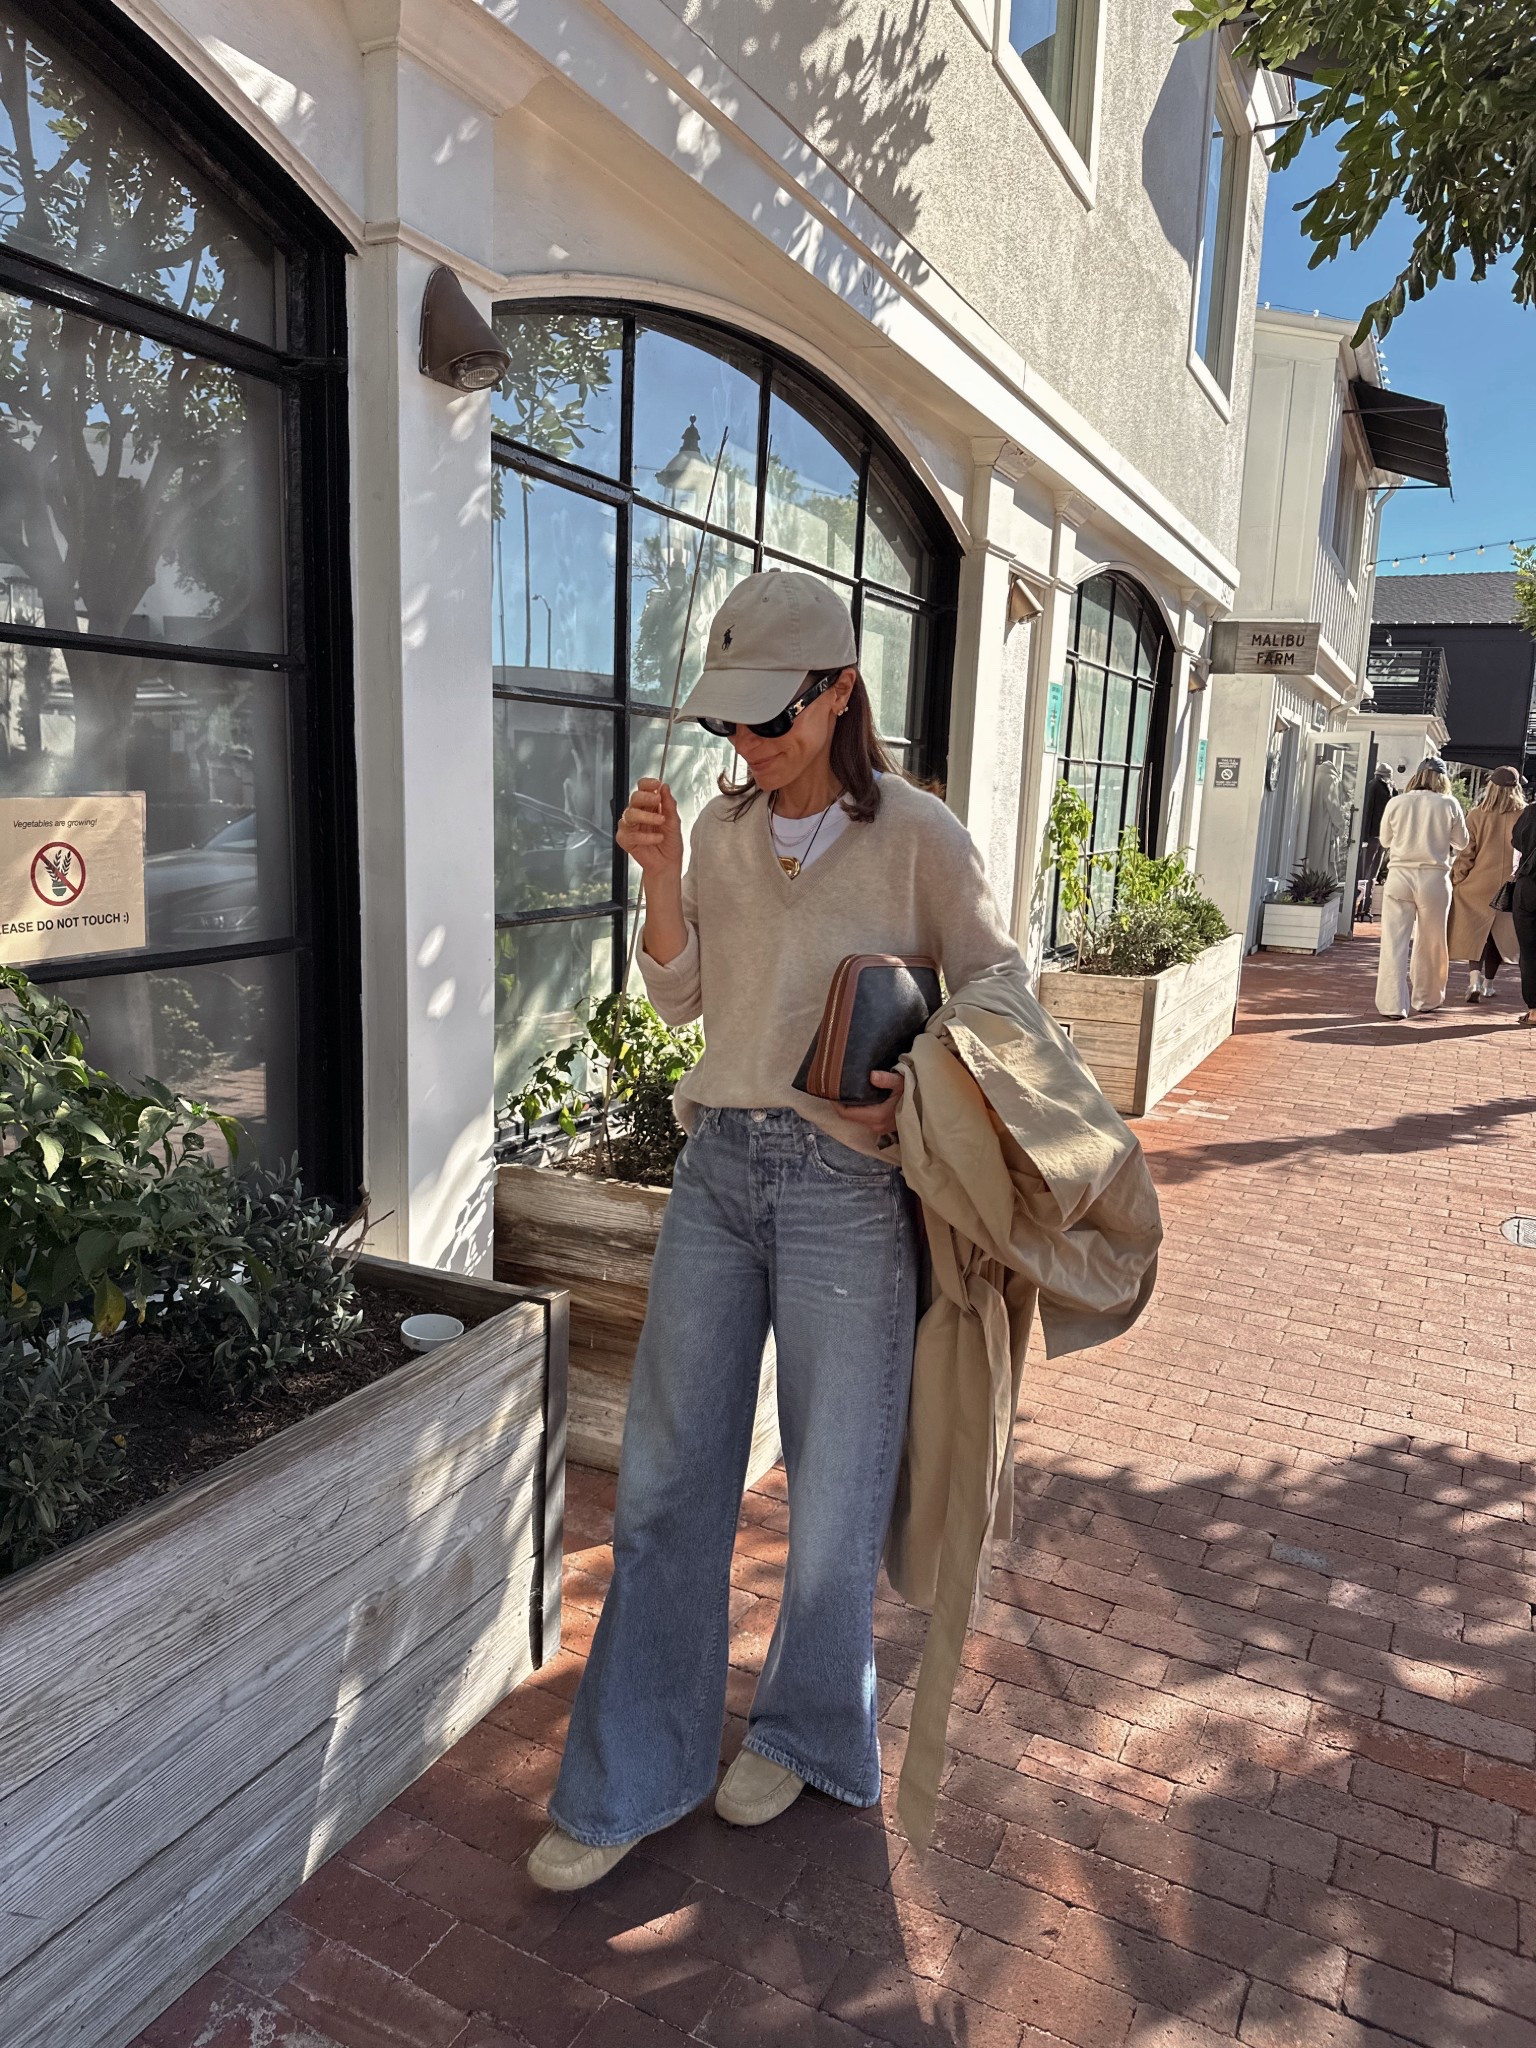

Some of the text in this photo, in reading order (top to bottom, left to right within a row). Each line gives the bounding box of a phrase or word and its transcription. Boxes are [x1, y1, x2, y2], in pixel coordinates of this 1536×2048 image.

[1251, 634, 1305, 647] MALIBU
[1256, 652, 1295, 666] FARM
[13, 820, 53, 829] Vegetables
[67, 818, 98, 828] growing!
[0, 922, 33, 935] EASE
[37, 920, 54, 931] DO
[57, 917, 79, 929] NOT
[82, 913, 120, 926] TOUCH
